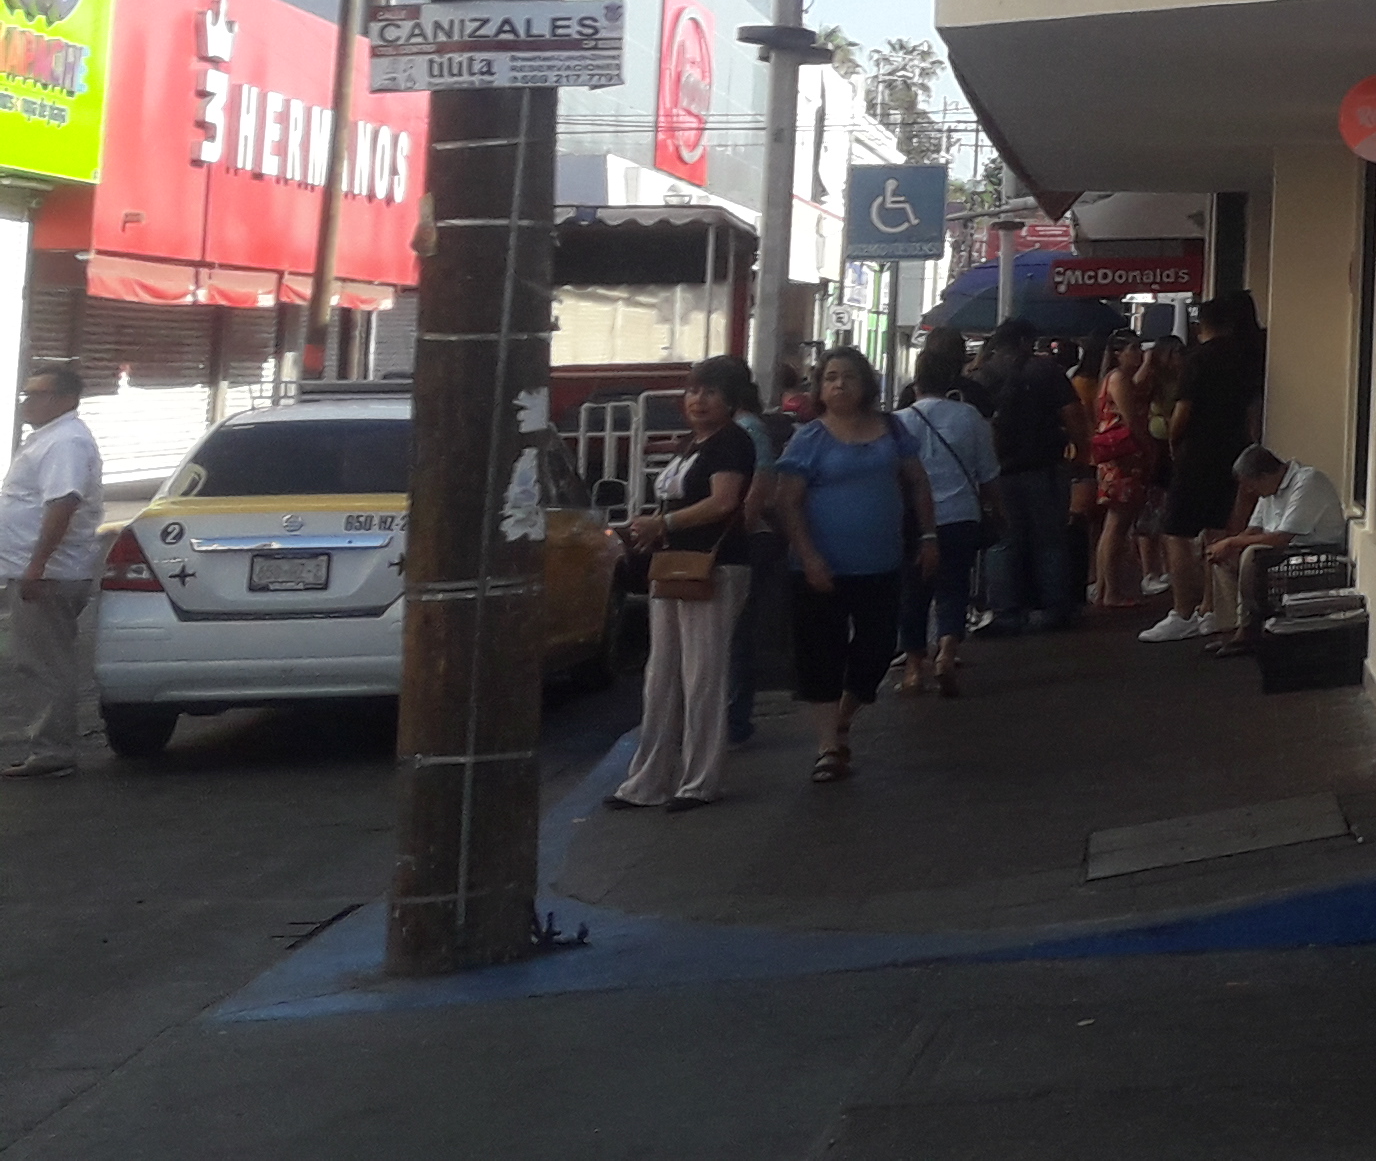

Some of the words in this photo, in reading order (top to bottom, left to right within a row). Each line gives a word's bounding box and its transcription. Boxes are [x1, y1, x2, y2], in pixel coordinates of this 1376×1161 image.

[380, 16, 600, 44] CANIZALES
[0, 23, 90, 98] APACHE
[197, 68, 230, 164] 3
[1066, 266, 1191, 287] McDonald's
